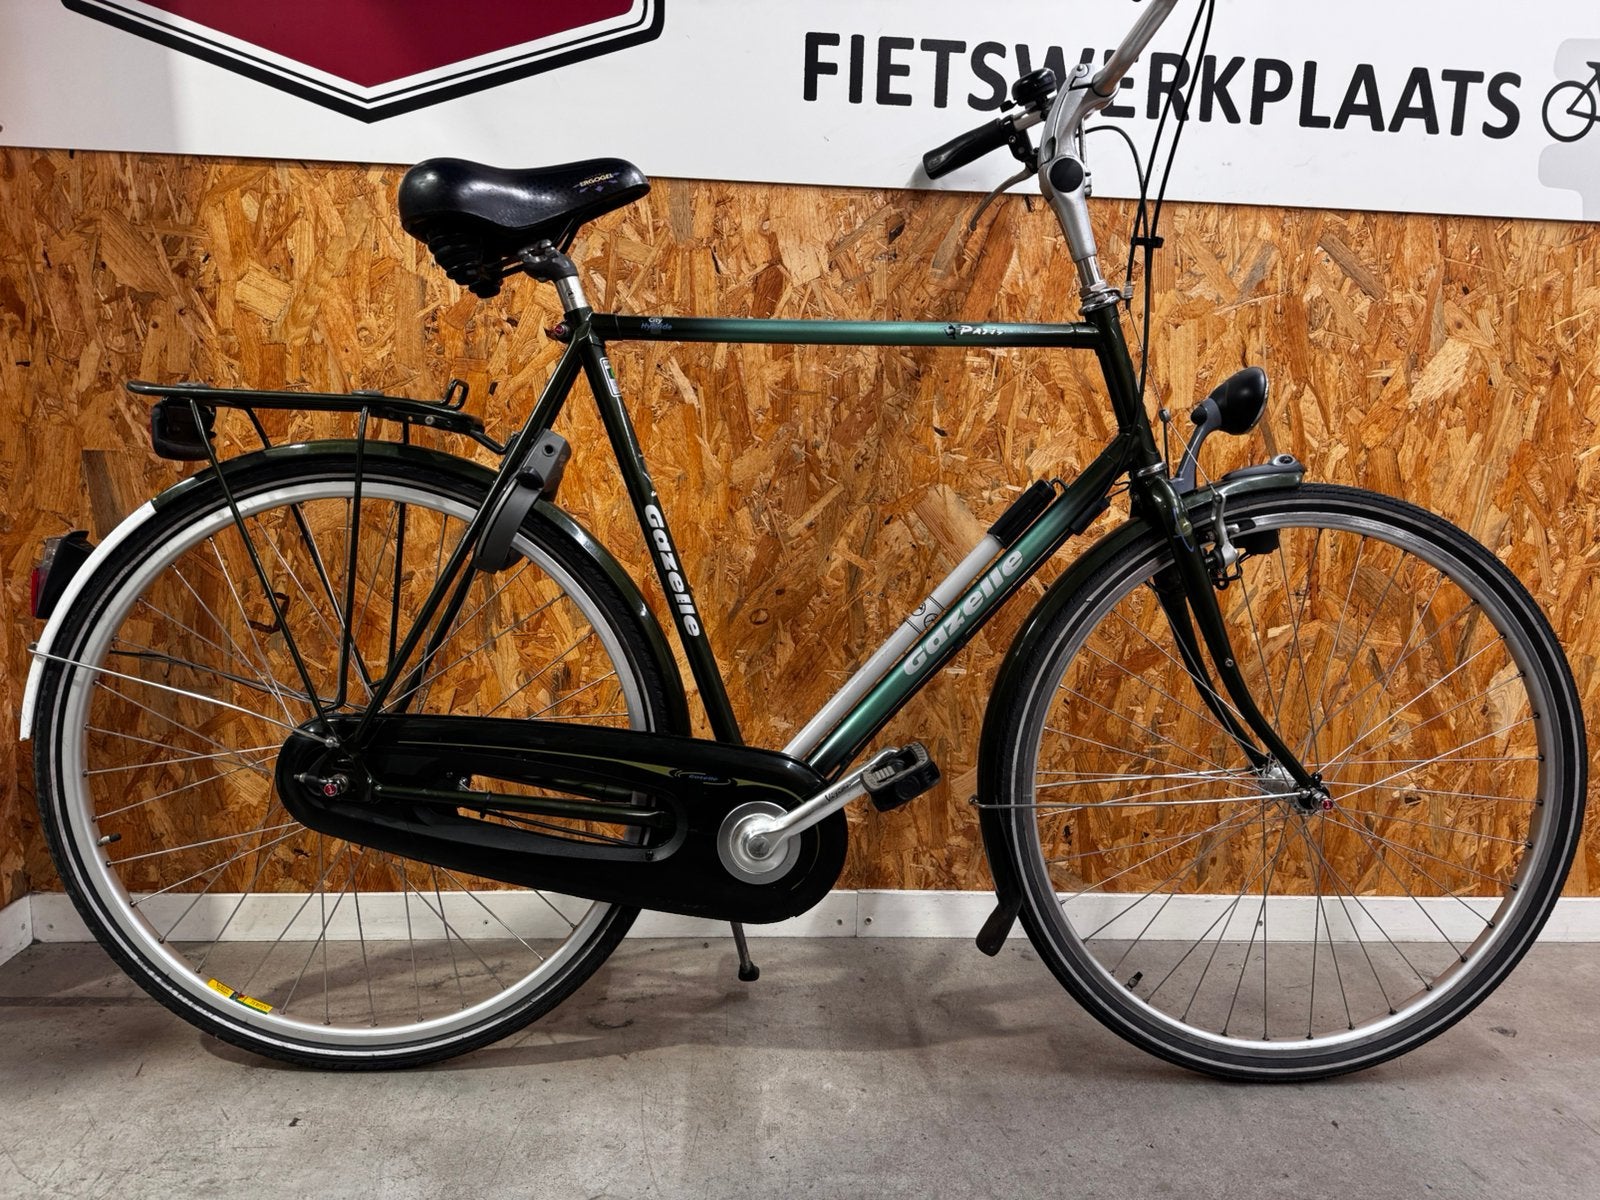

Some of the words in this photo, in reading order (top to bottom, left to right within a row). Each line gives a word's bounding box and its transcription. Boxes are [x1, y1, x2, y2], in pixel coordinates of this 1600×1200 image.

[579, 172, 614, 187] ERGOGEL
[644, 504, 700, 637] Gazelle
[903, 550, 1023, 676] Gazelle
